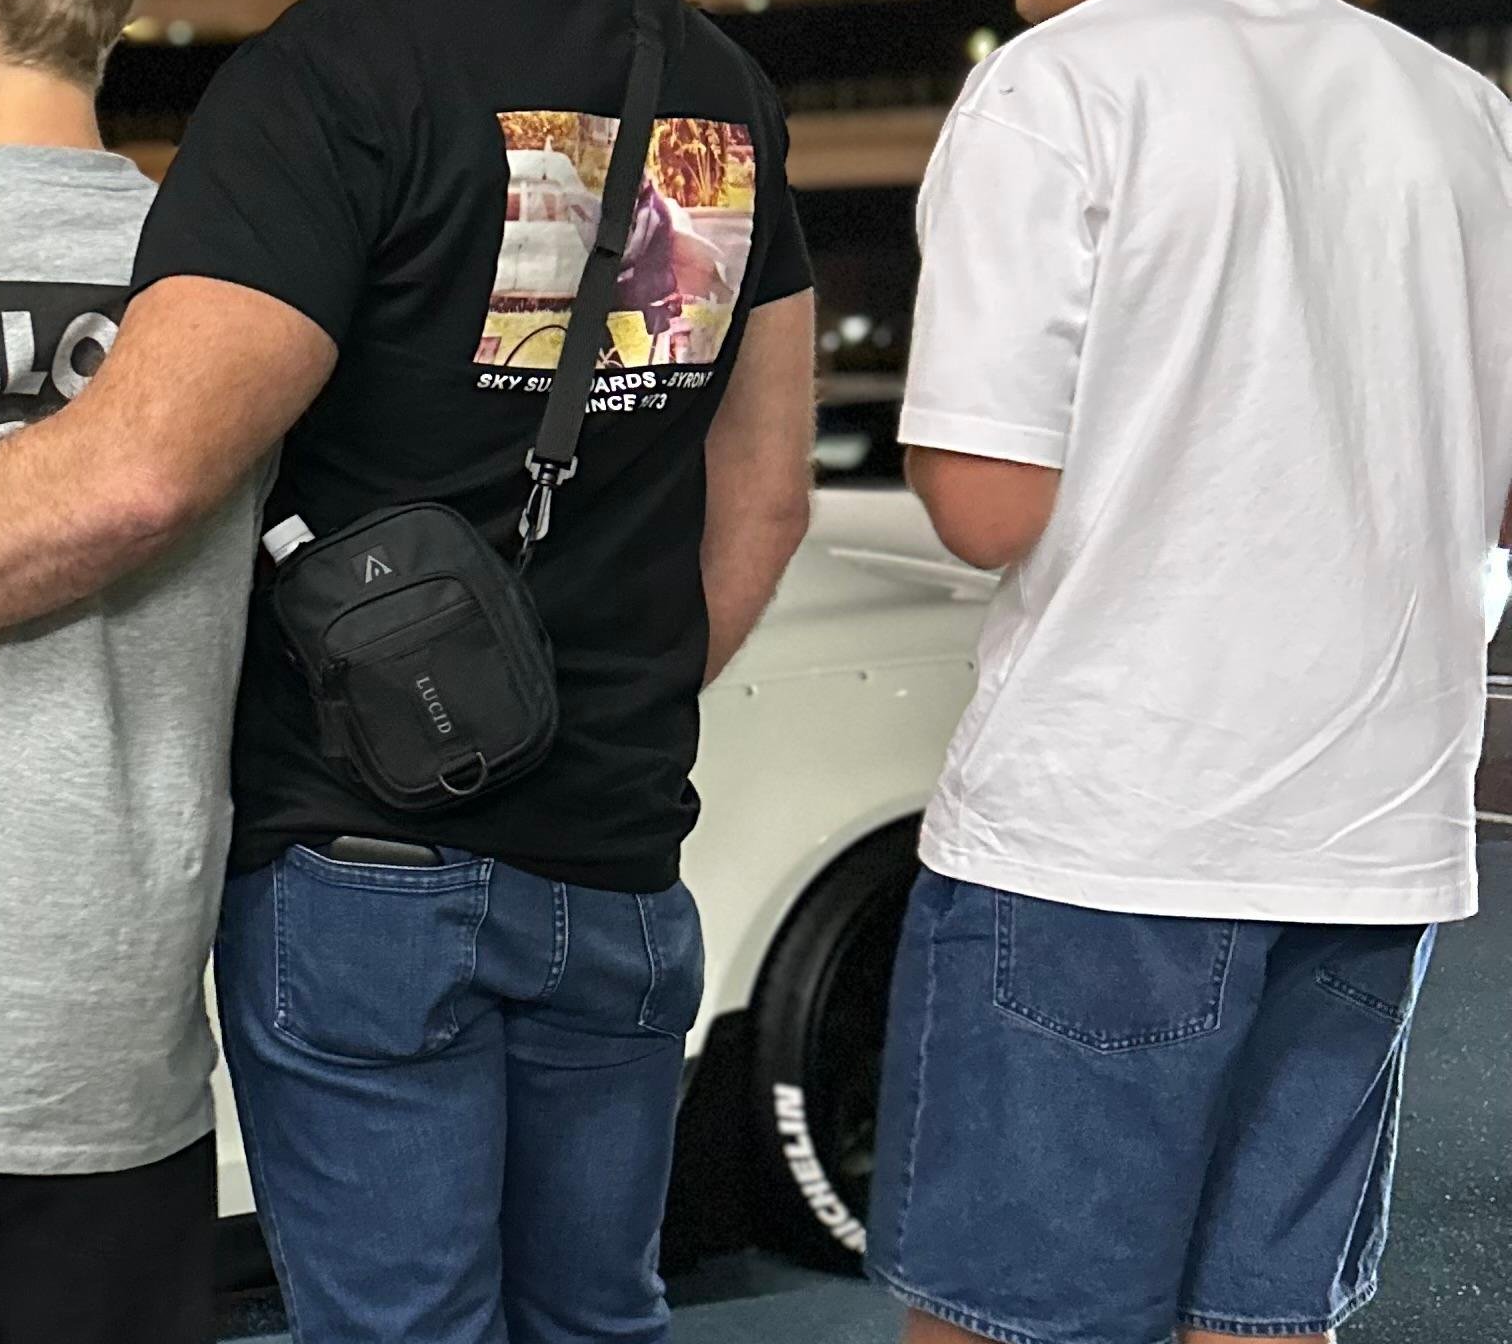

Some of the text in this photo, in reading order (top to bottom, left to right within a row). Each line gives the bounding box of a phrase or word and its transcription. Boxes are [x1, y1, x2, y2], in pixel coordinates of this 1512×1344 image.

[476, 373, 523, 390] SKY
[584, 394, 637, 414] INCE
[416, 676, 452, 734] LUCID
